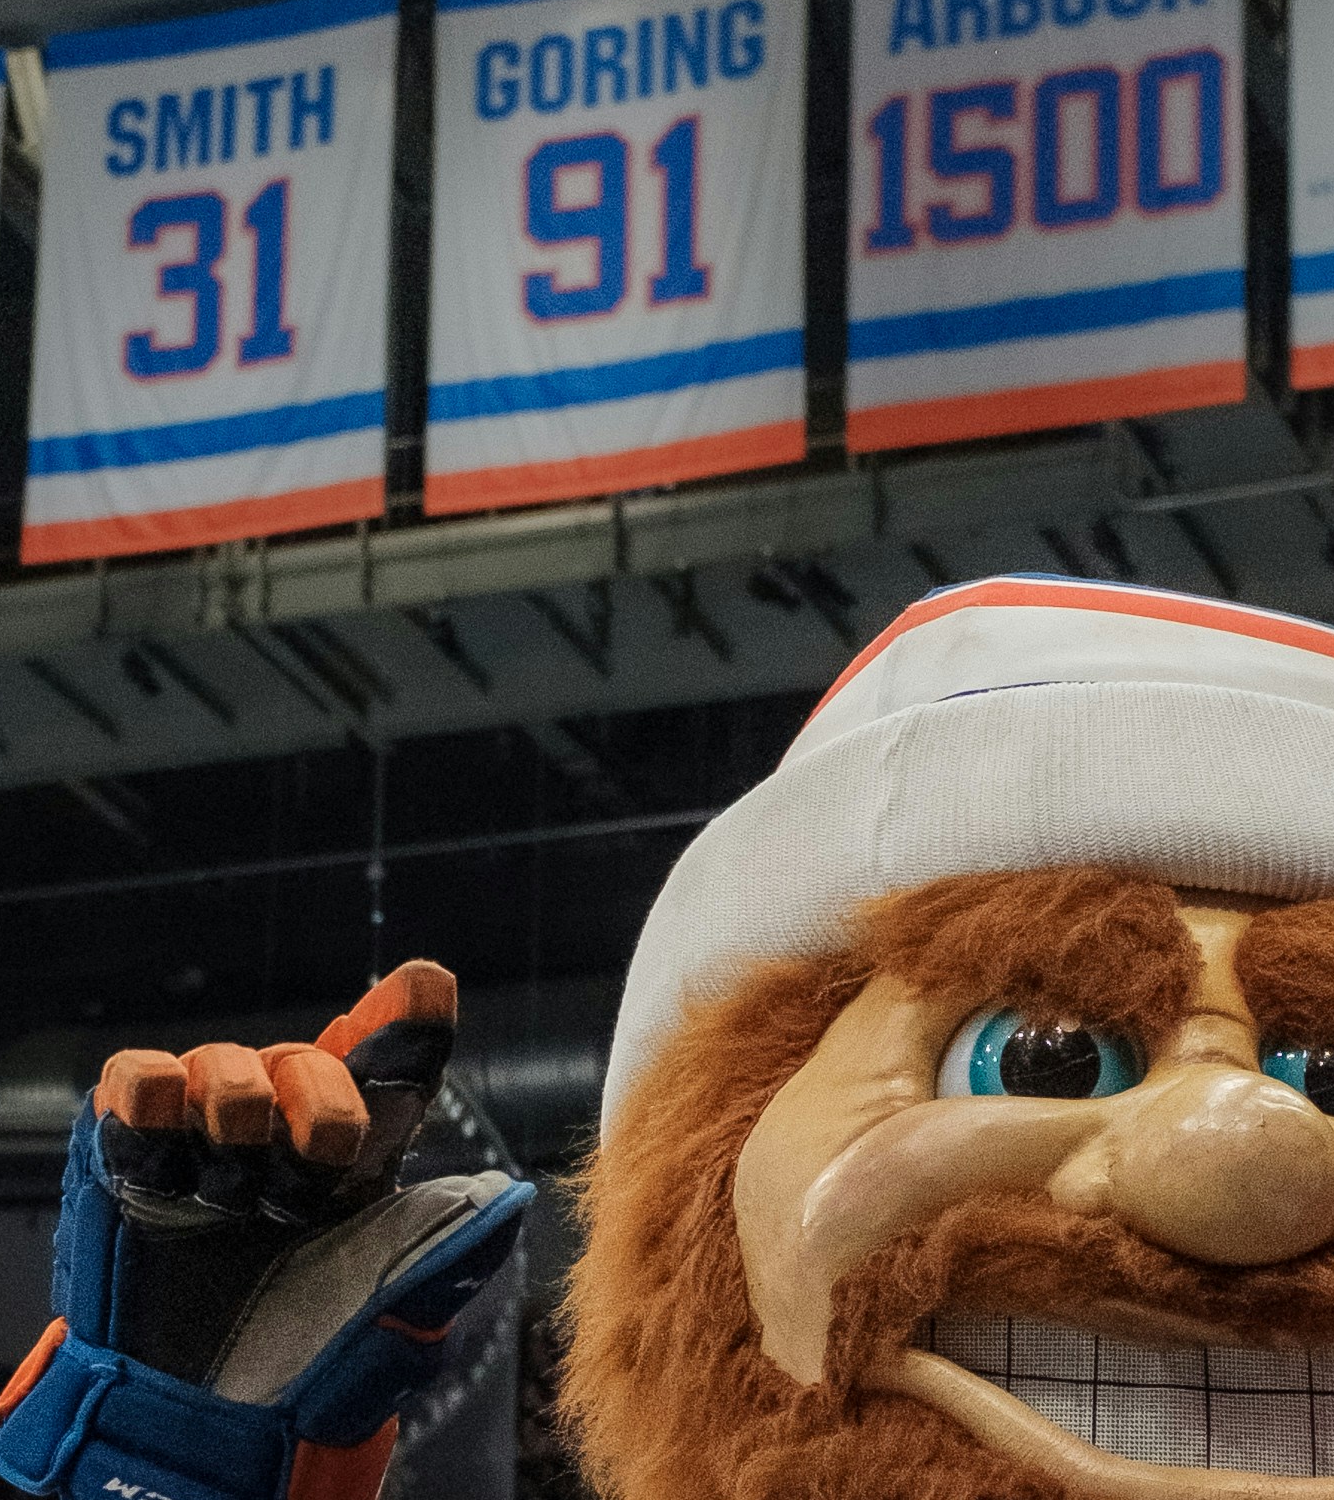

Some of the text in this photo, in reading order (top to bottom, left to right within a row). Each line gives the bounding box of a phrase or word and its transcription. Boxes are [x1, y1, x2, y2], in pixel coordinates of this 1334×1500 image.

[104, 64, 336, 178] SMITH
[520, 113, 712, 326] 91
[861, 45, 1227, 257] 1500
[121, 176, 297, 384] 31
